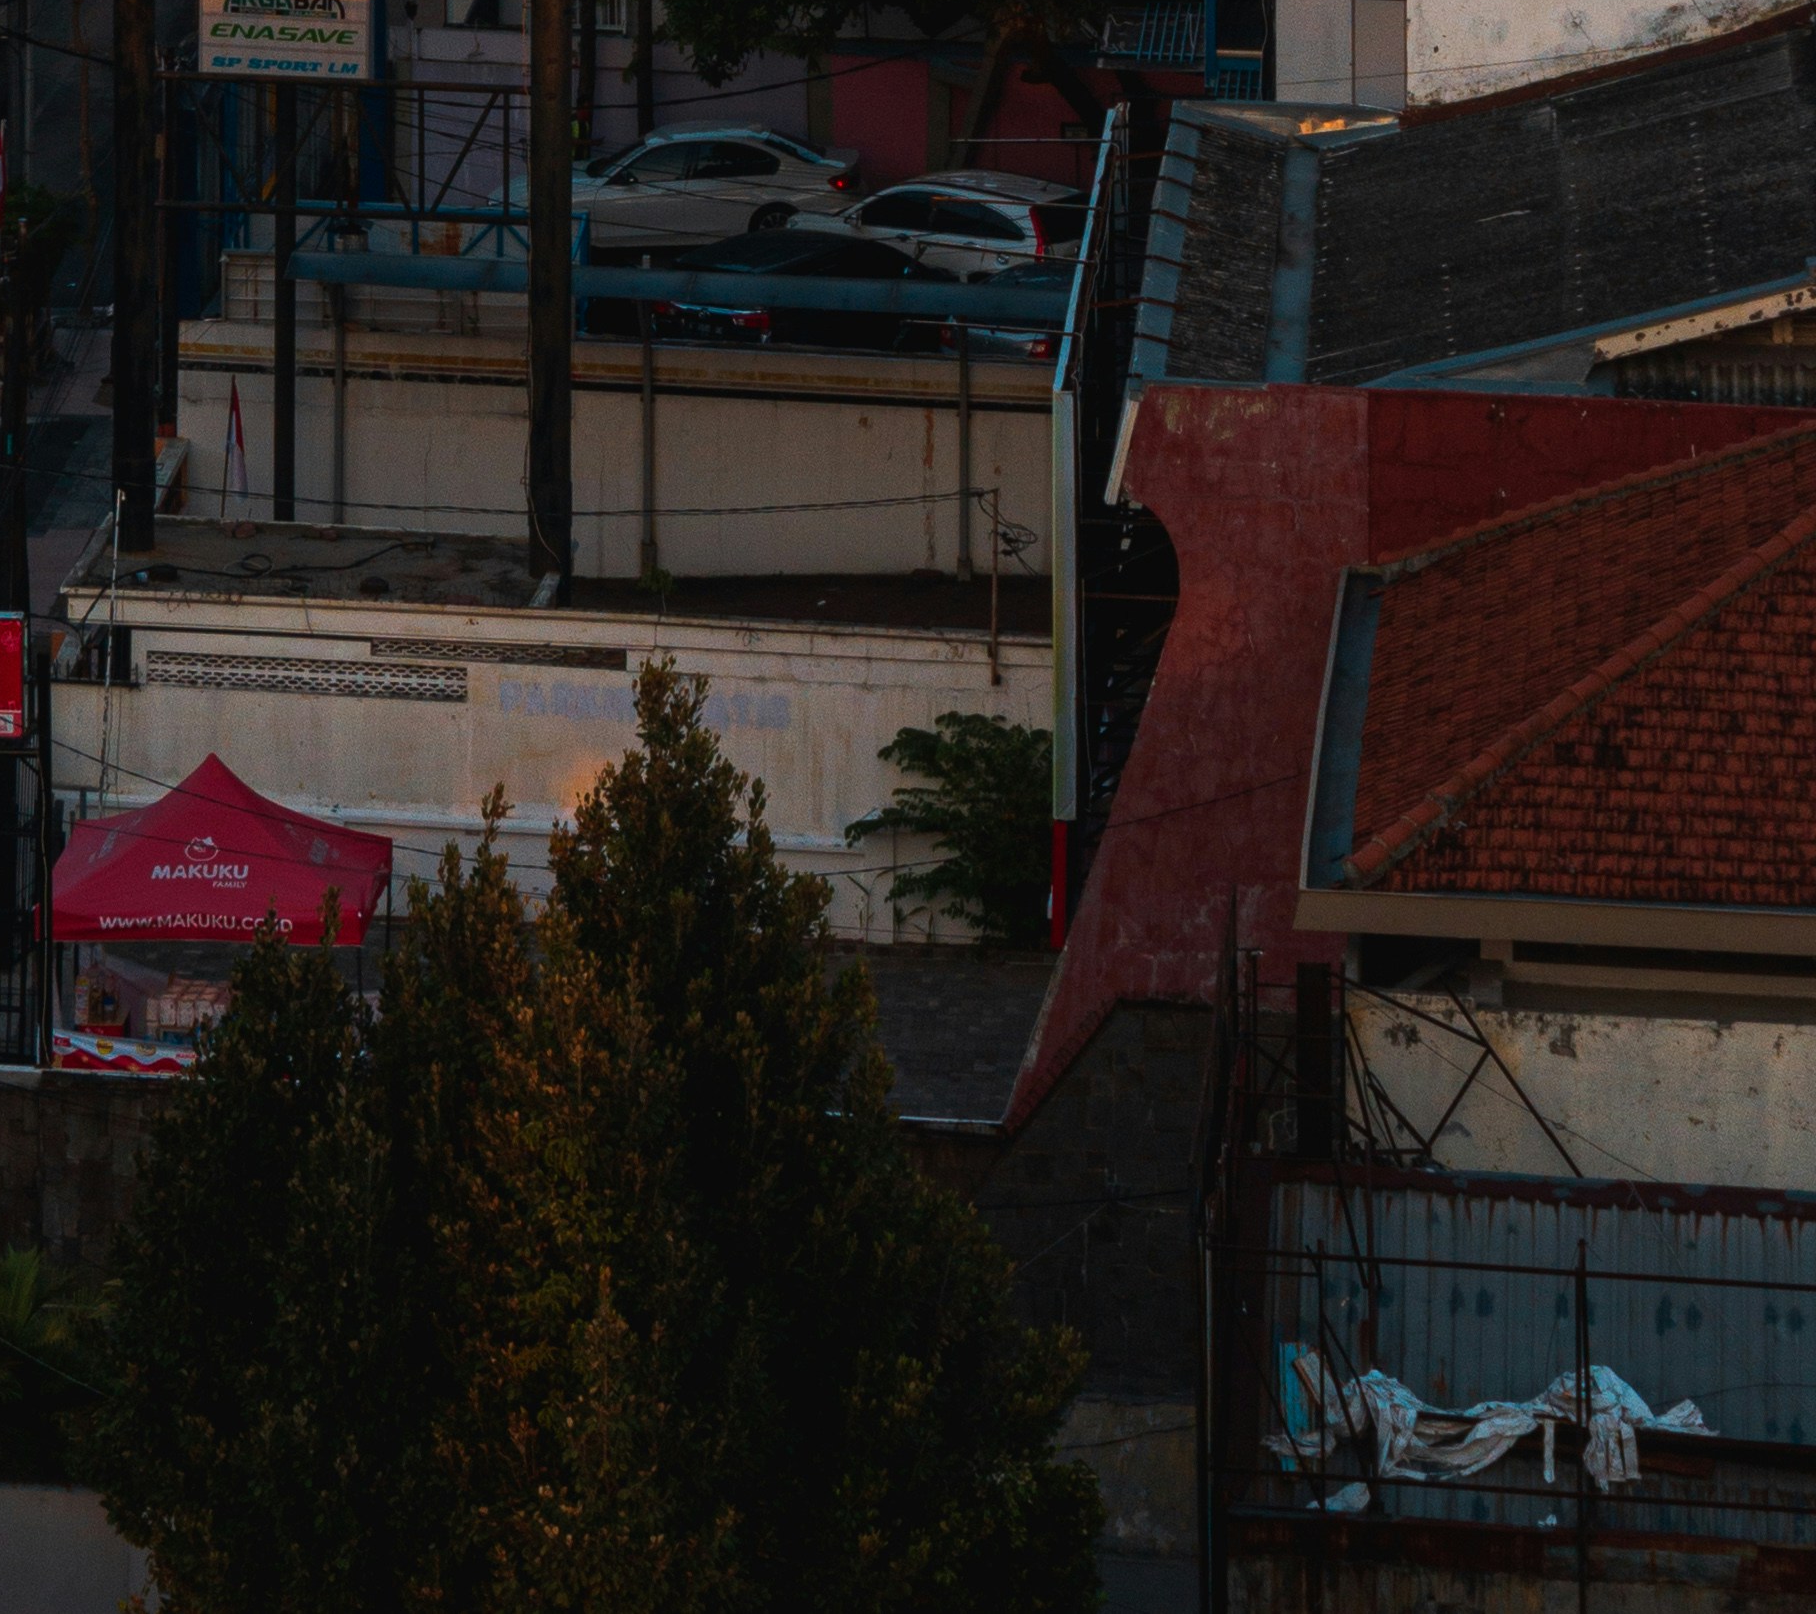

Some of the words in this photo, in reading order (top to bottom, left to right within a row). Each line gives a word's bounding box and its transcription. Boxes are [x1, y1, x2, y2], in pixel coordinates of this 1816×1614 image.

[210, 23, 359, 45] ENASAVE
[212, 55, 242, 67] SP
[247, 58, 323, 72] SPORT
[328, 62, 359, 74] LM
[151, 864, 249, 880] MAKUKU
[212, 880, 248, 889] FAMILY
